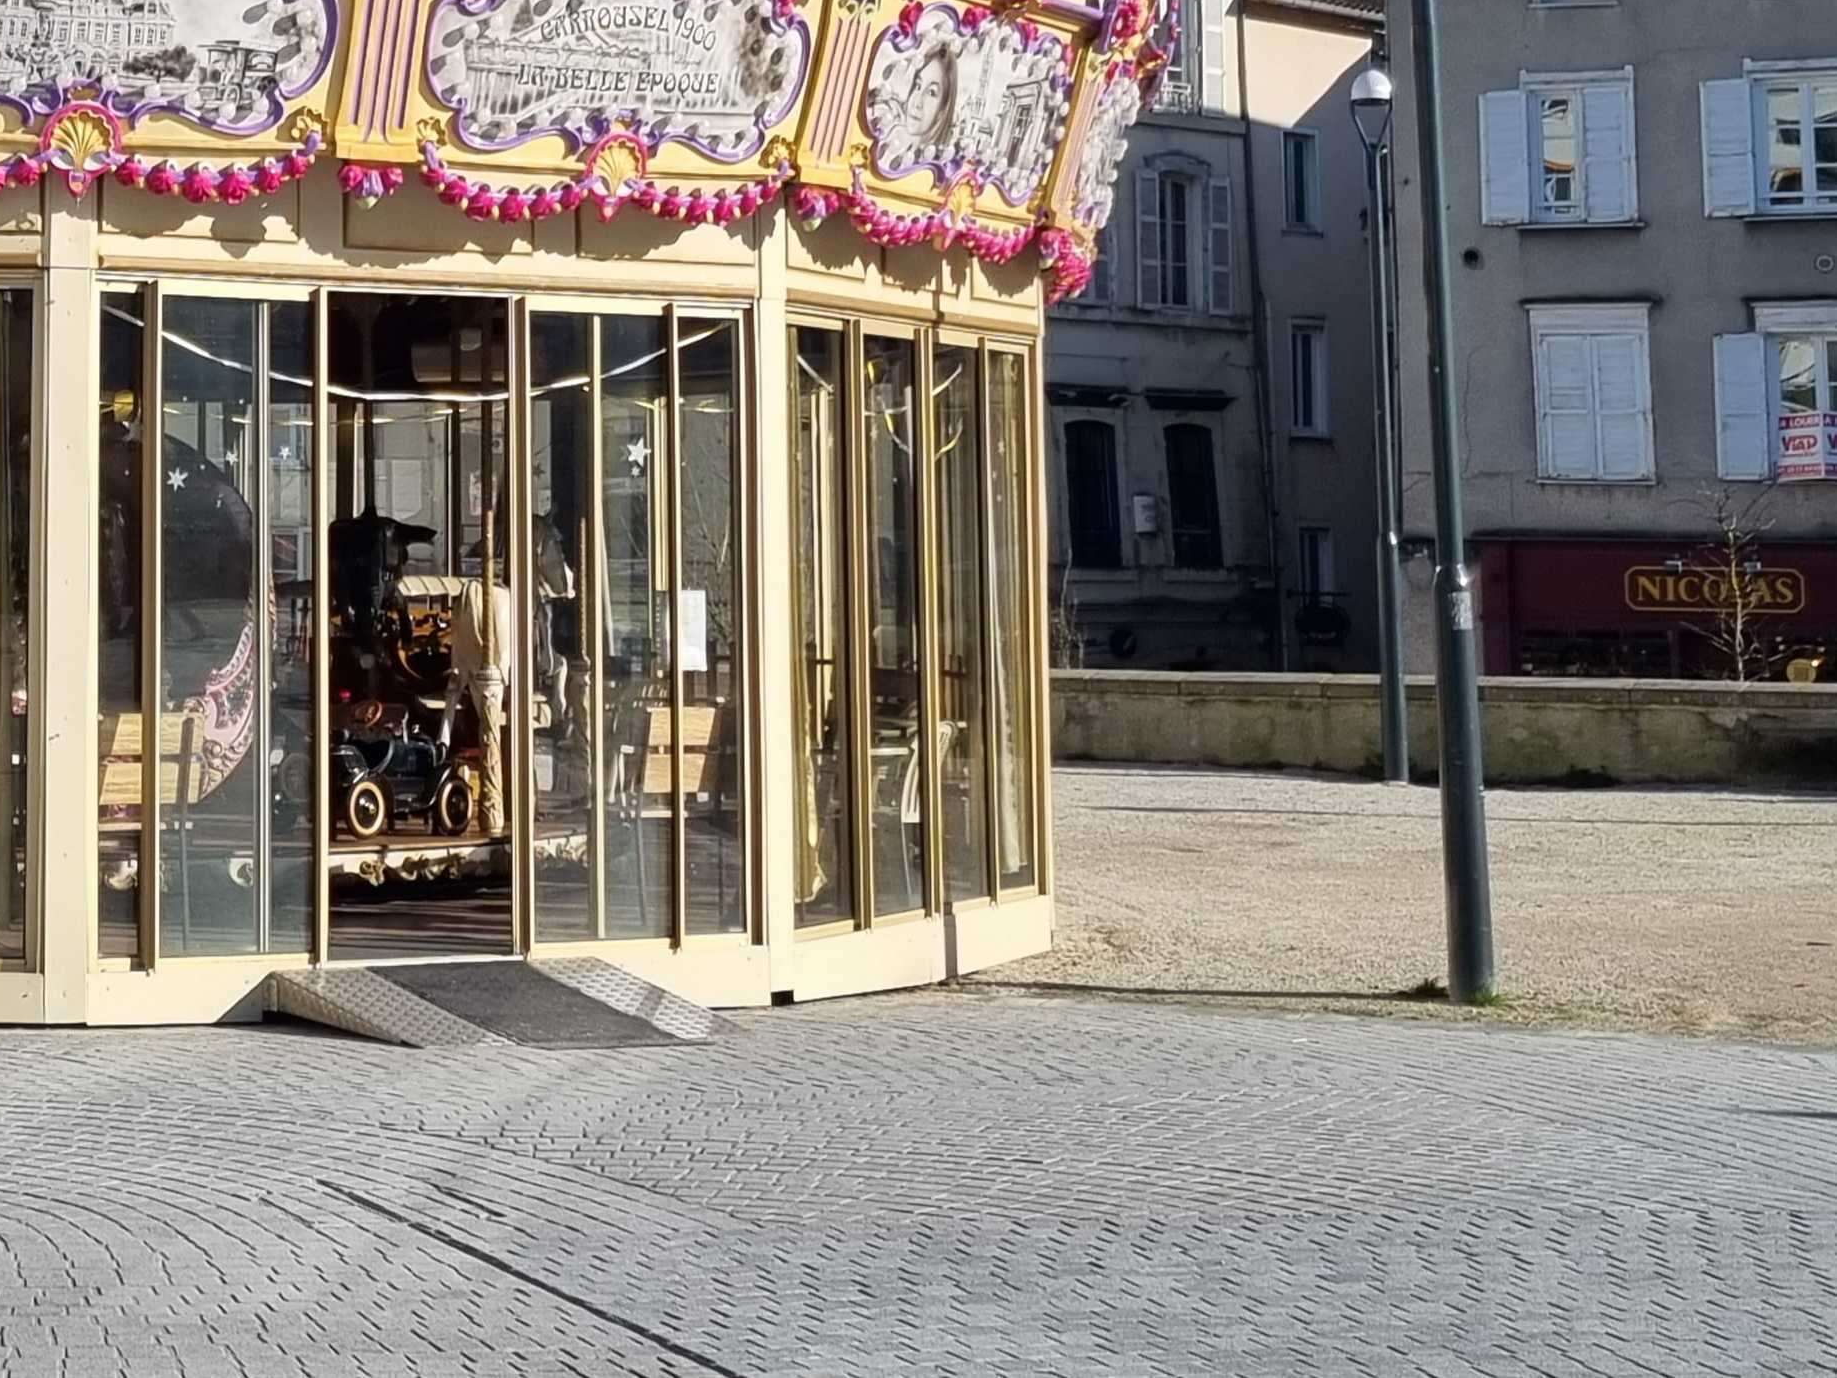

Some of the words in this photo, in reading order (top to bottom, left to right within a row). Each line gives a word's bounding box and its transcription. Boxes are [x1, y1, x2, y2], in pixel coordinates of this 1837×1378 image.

[540, 5, 670, 42] CARROUSEL
[674, 15, 717, 52] 1900
[517, 64, 547, 86] LA
[554, 68, 628, 93] BELLE
[635, 72, 719, 98] EPOQUE
